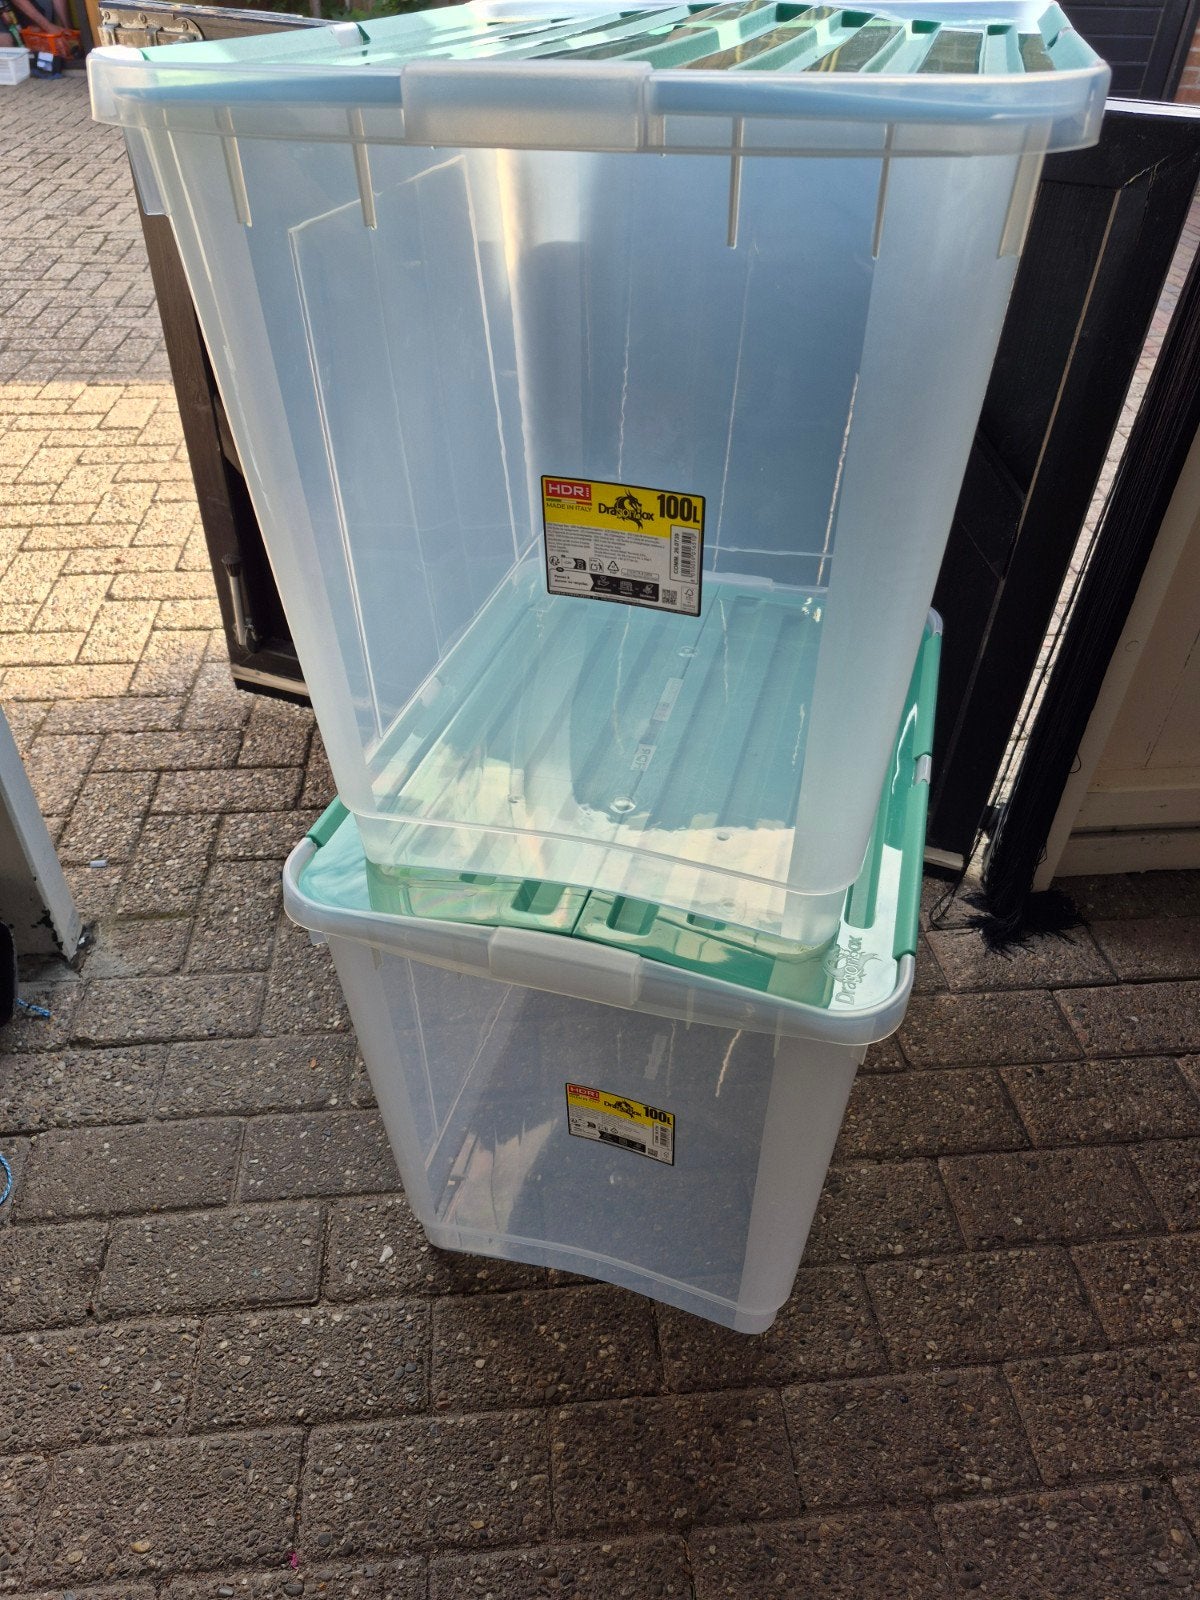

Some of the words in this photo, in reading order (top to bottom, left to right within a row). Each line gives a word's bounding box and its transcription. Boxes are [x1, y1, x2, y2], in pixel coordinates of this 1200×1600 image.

[548, 483, 584, 497] HDR
[546, 502, 565, 510] MADE
[575, 505, 592, 513] ITALY
[656, 493, 700, 523] 100L
[643, 1106, 672, 1125] 100L
